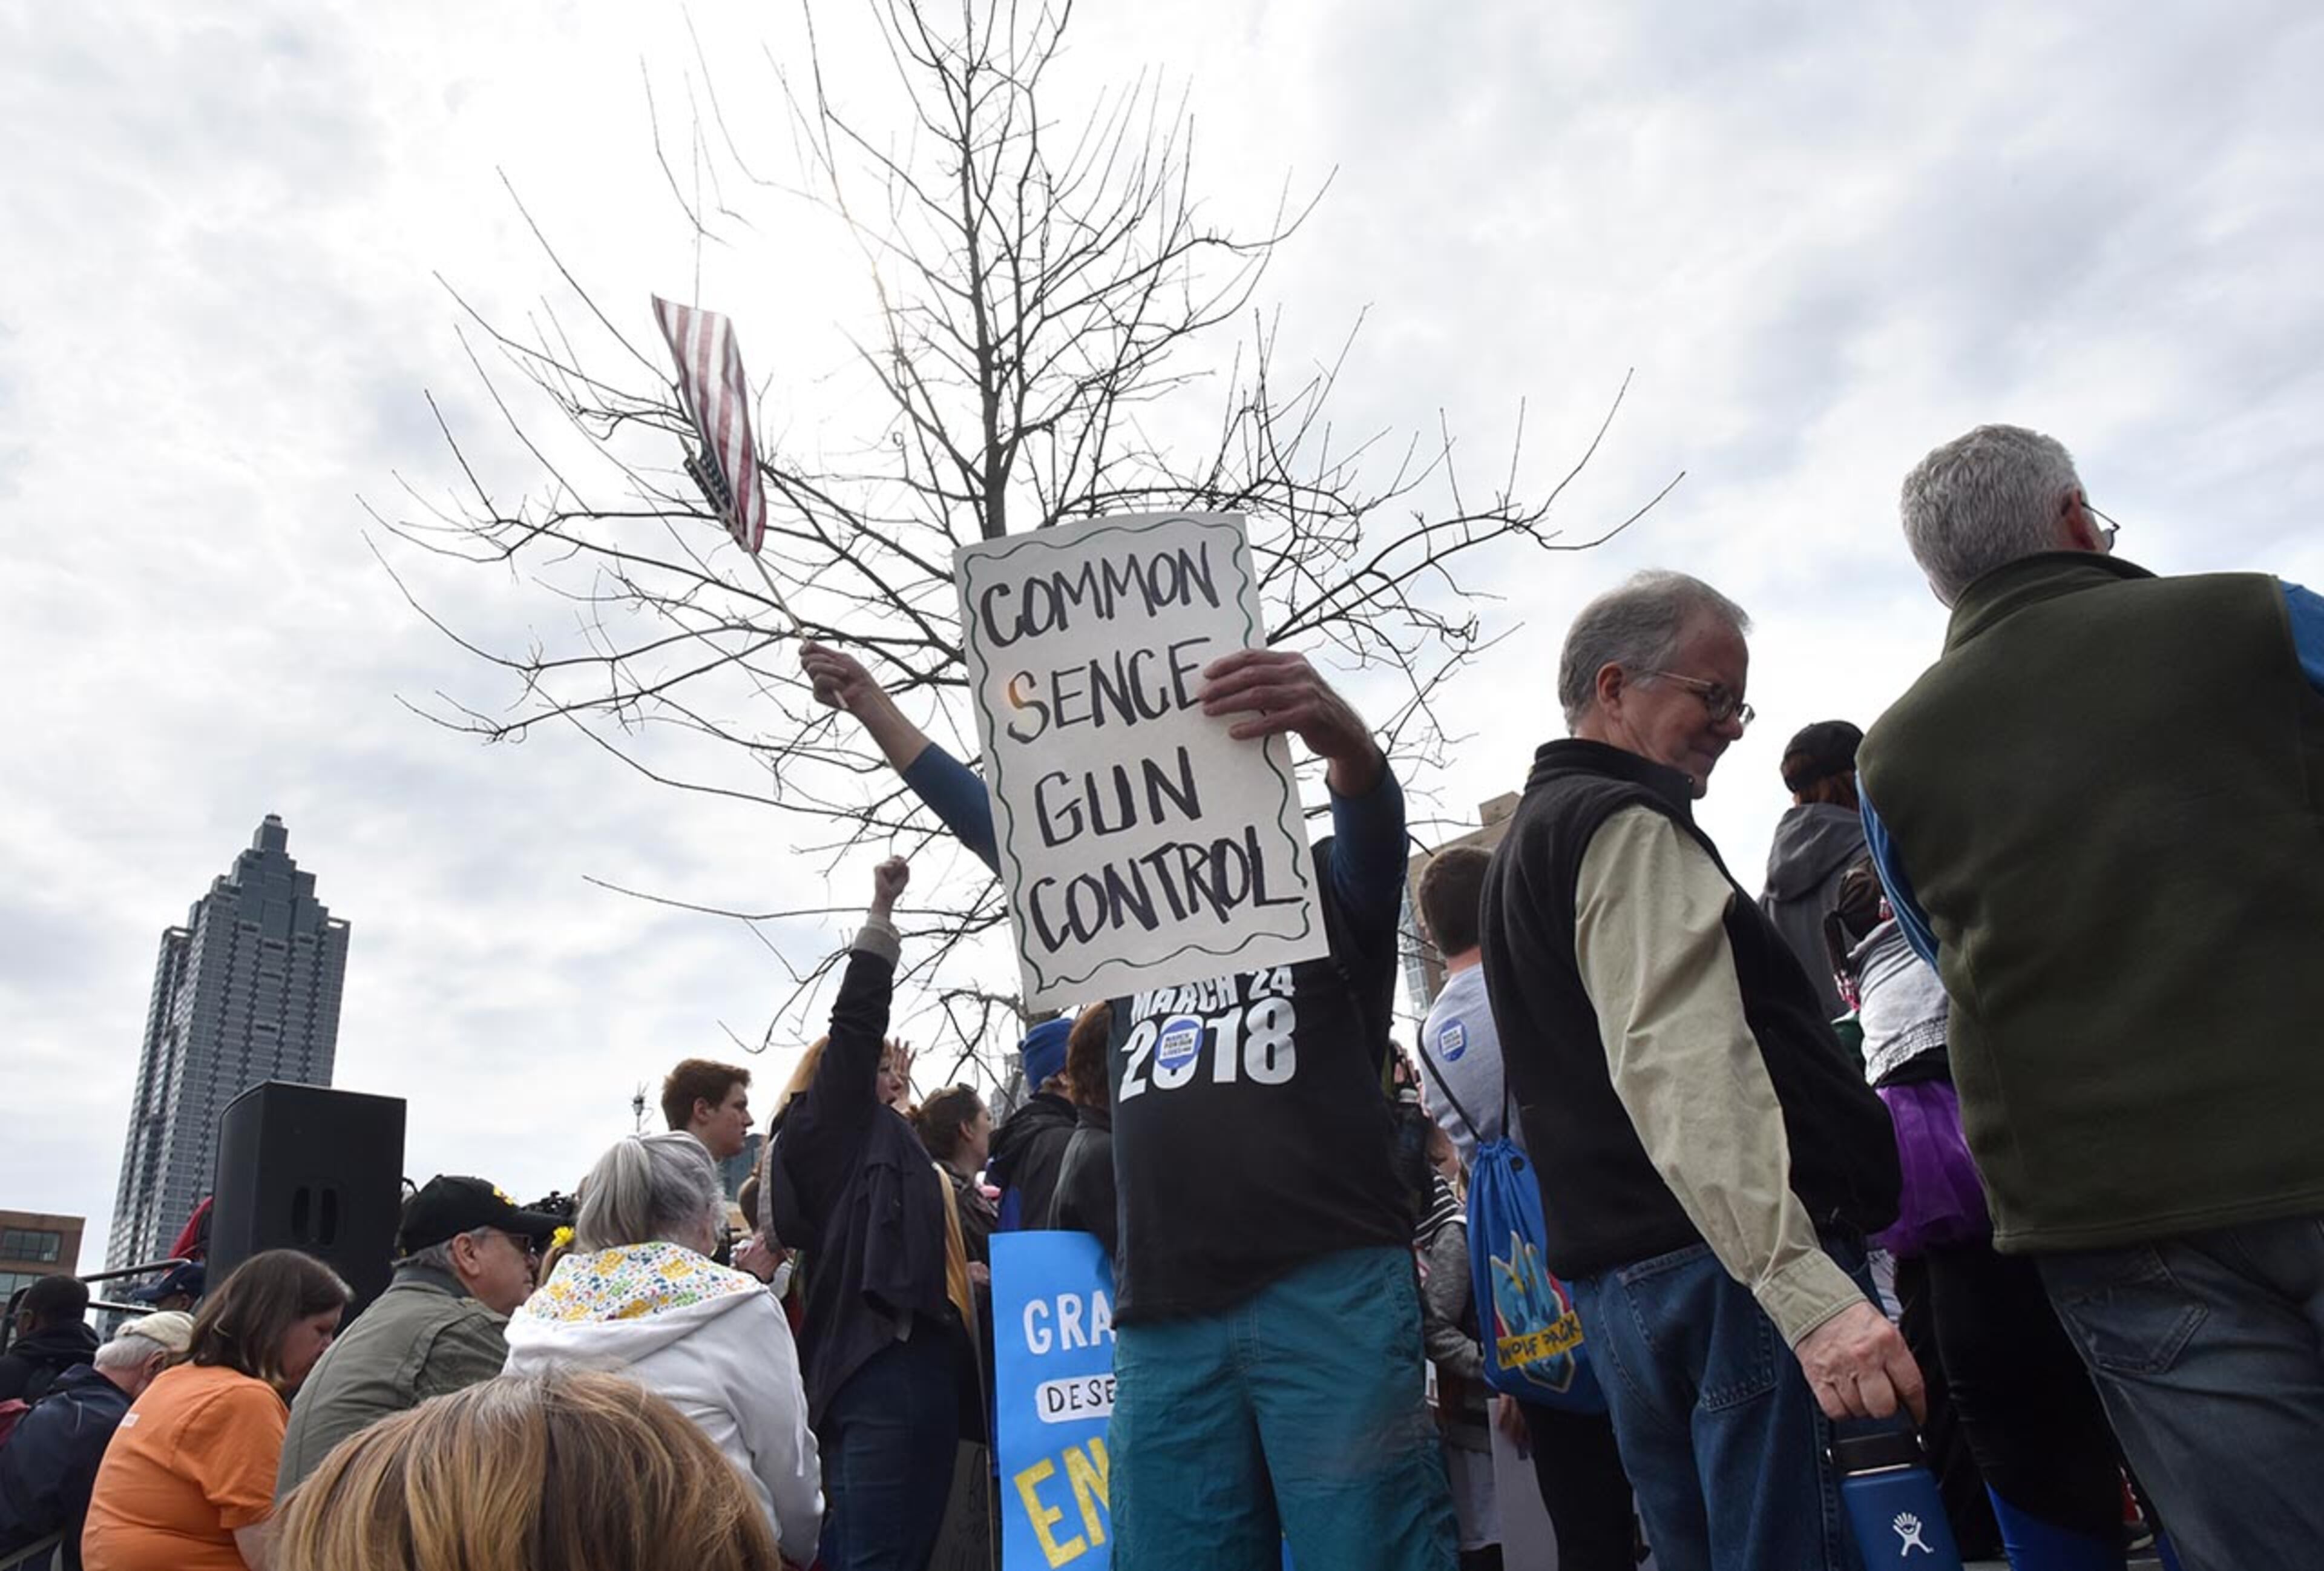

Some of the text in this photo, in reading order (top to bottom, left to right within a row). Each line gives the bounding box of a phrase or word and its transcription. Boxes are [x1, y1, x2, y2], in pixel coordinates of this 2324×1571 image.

[980, 541, 1220, 647] COMMON
[1006, 637, 1210, 743] SENCE
[1034, 746, 1203, 847] GUN
[1028, 826, 1305, 953] CONTROL
[1119, 996, 1296, 1103] 2018
[1131, 966, 1295, 1027] MARCH 24
